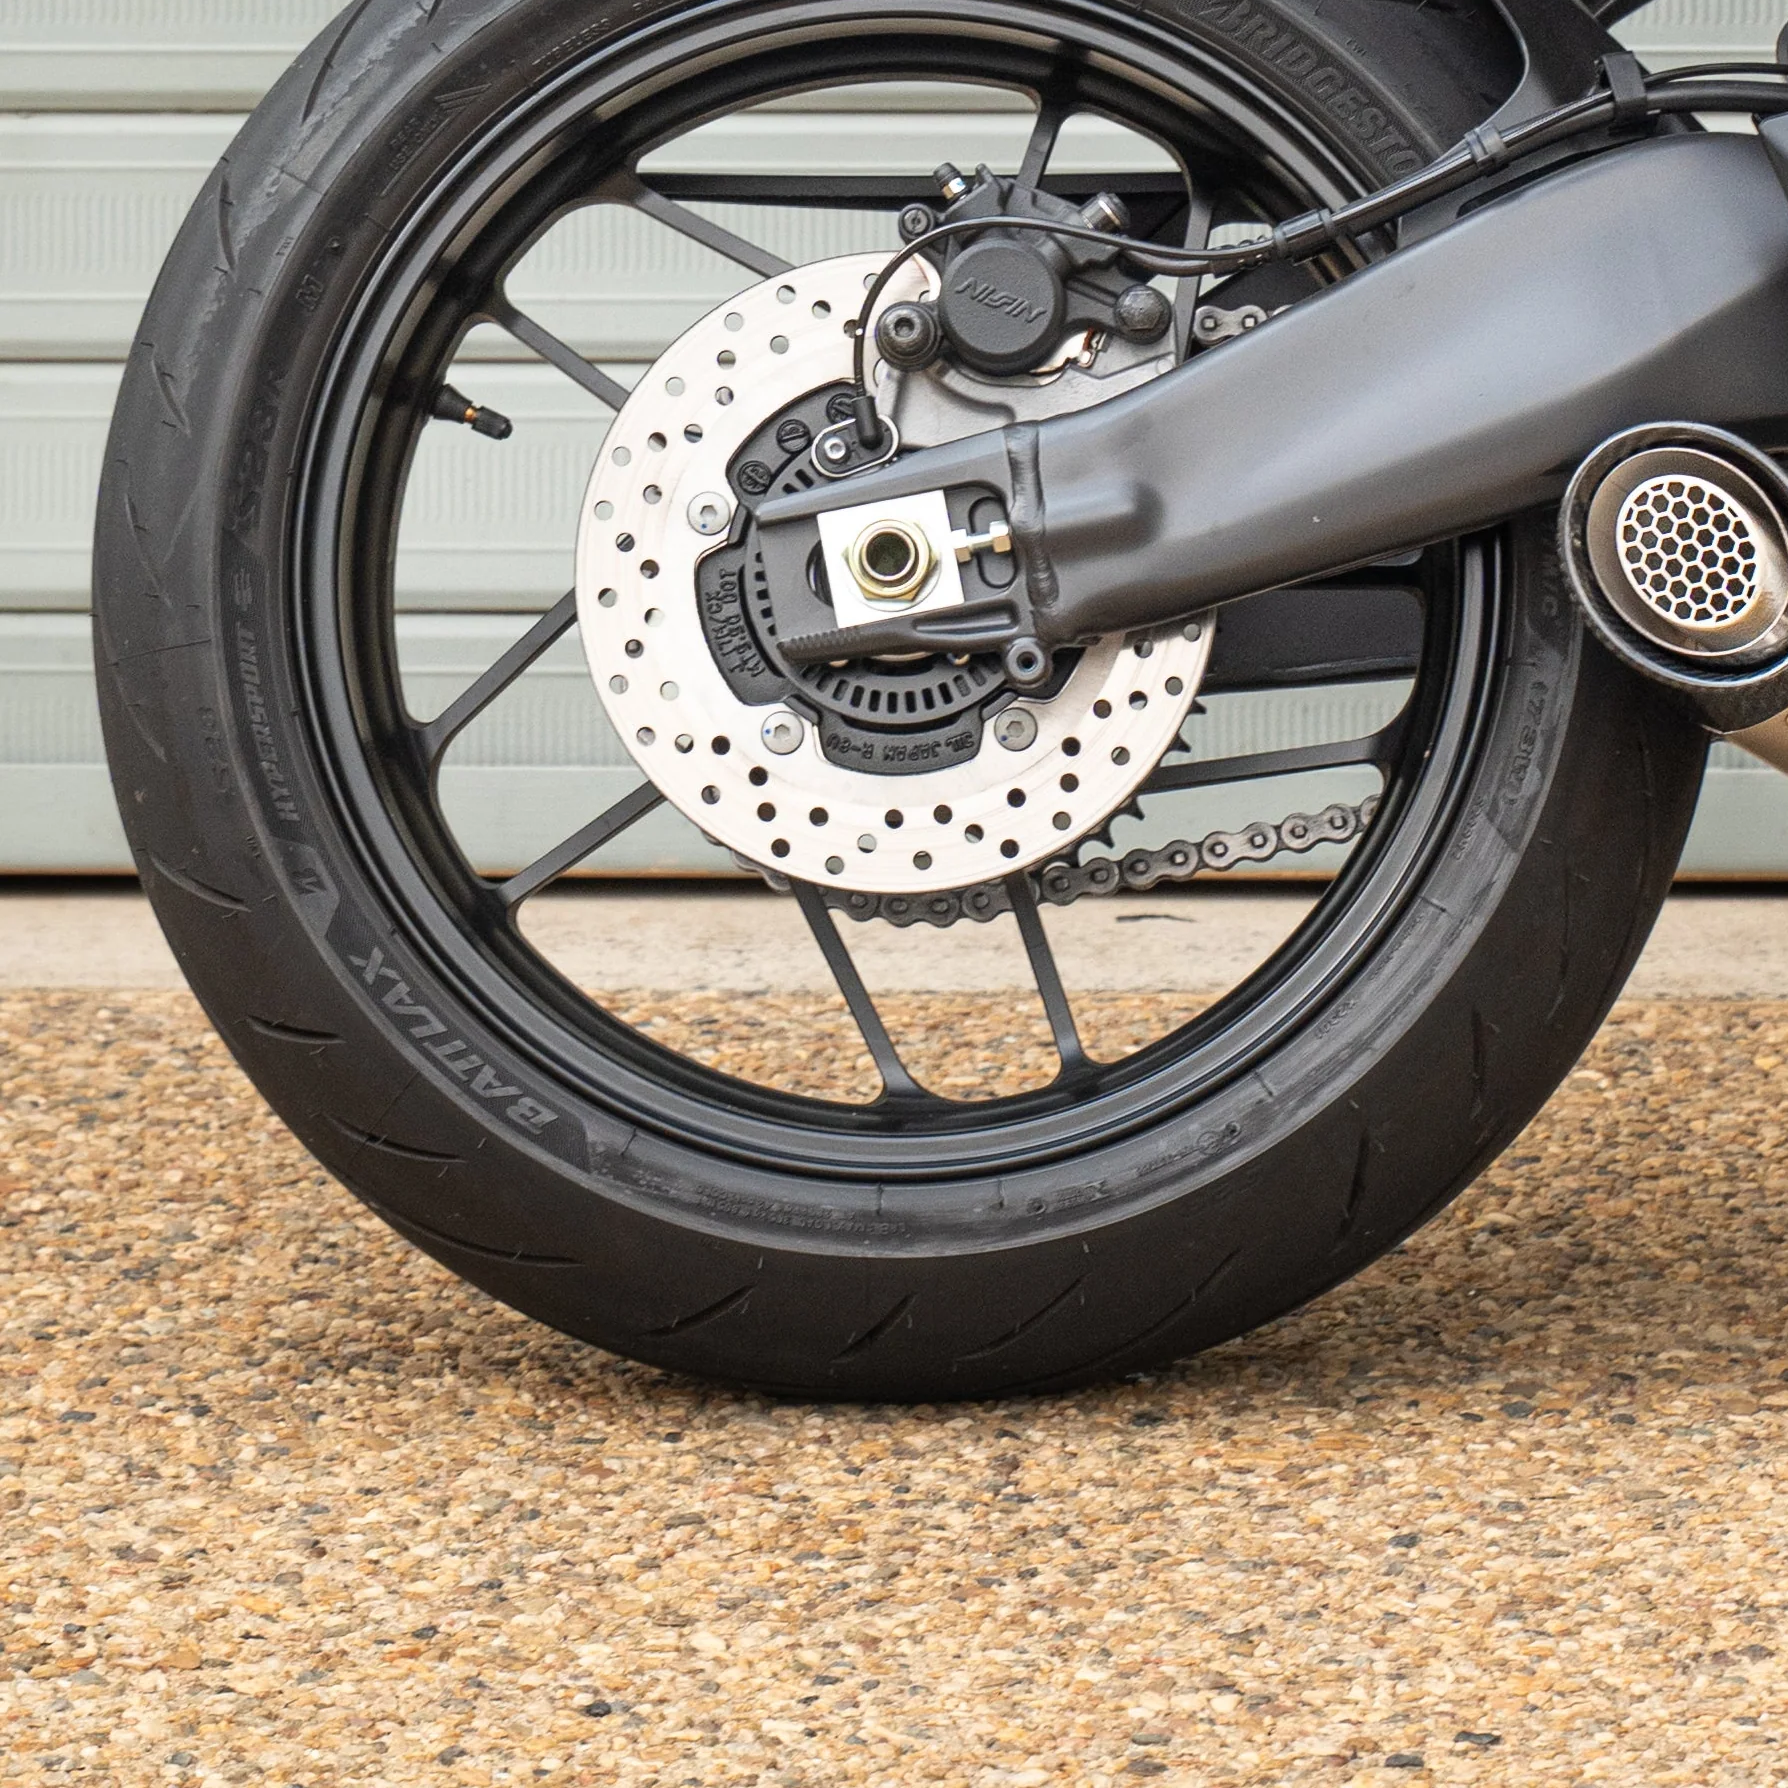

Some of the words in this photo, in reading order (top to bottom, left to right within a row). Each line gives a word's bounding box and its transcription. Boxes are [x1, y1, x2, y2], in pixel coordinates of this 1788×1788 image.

[956, 277, 1047, 324] NISSIN
[237, 622, 300, 822] HYPERSPORT
[883, 741, 941, 762] JAPAN
[350, 946, 558, 1134] BATTLAX
